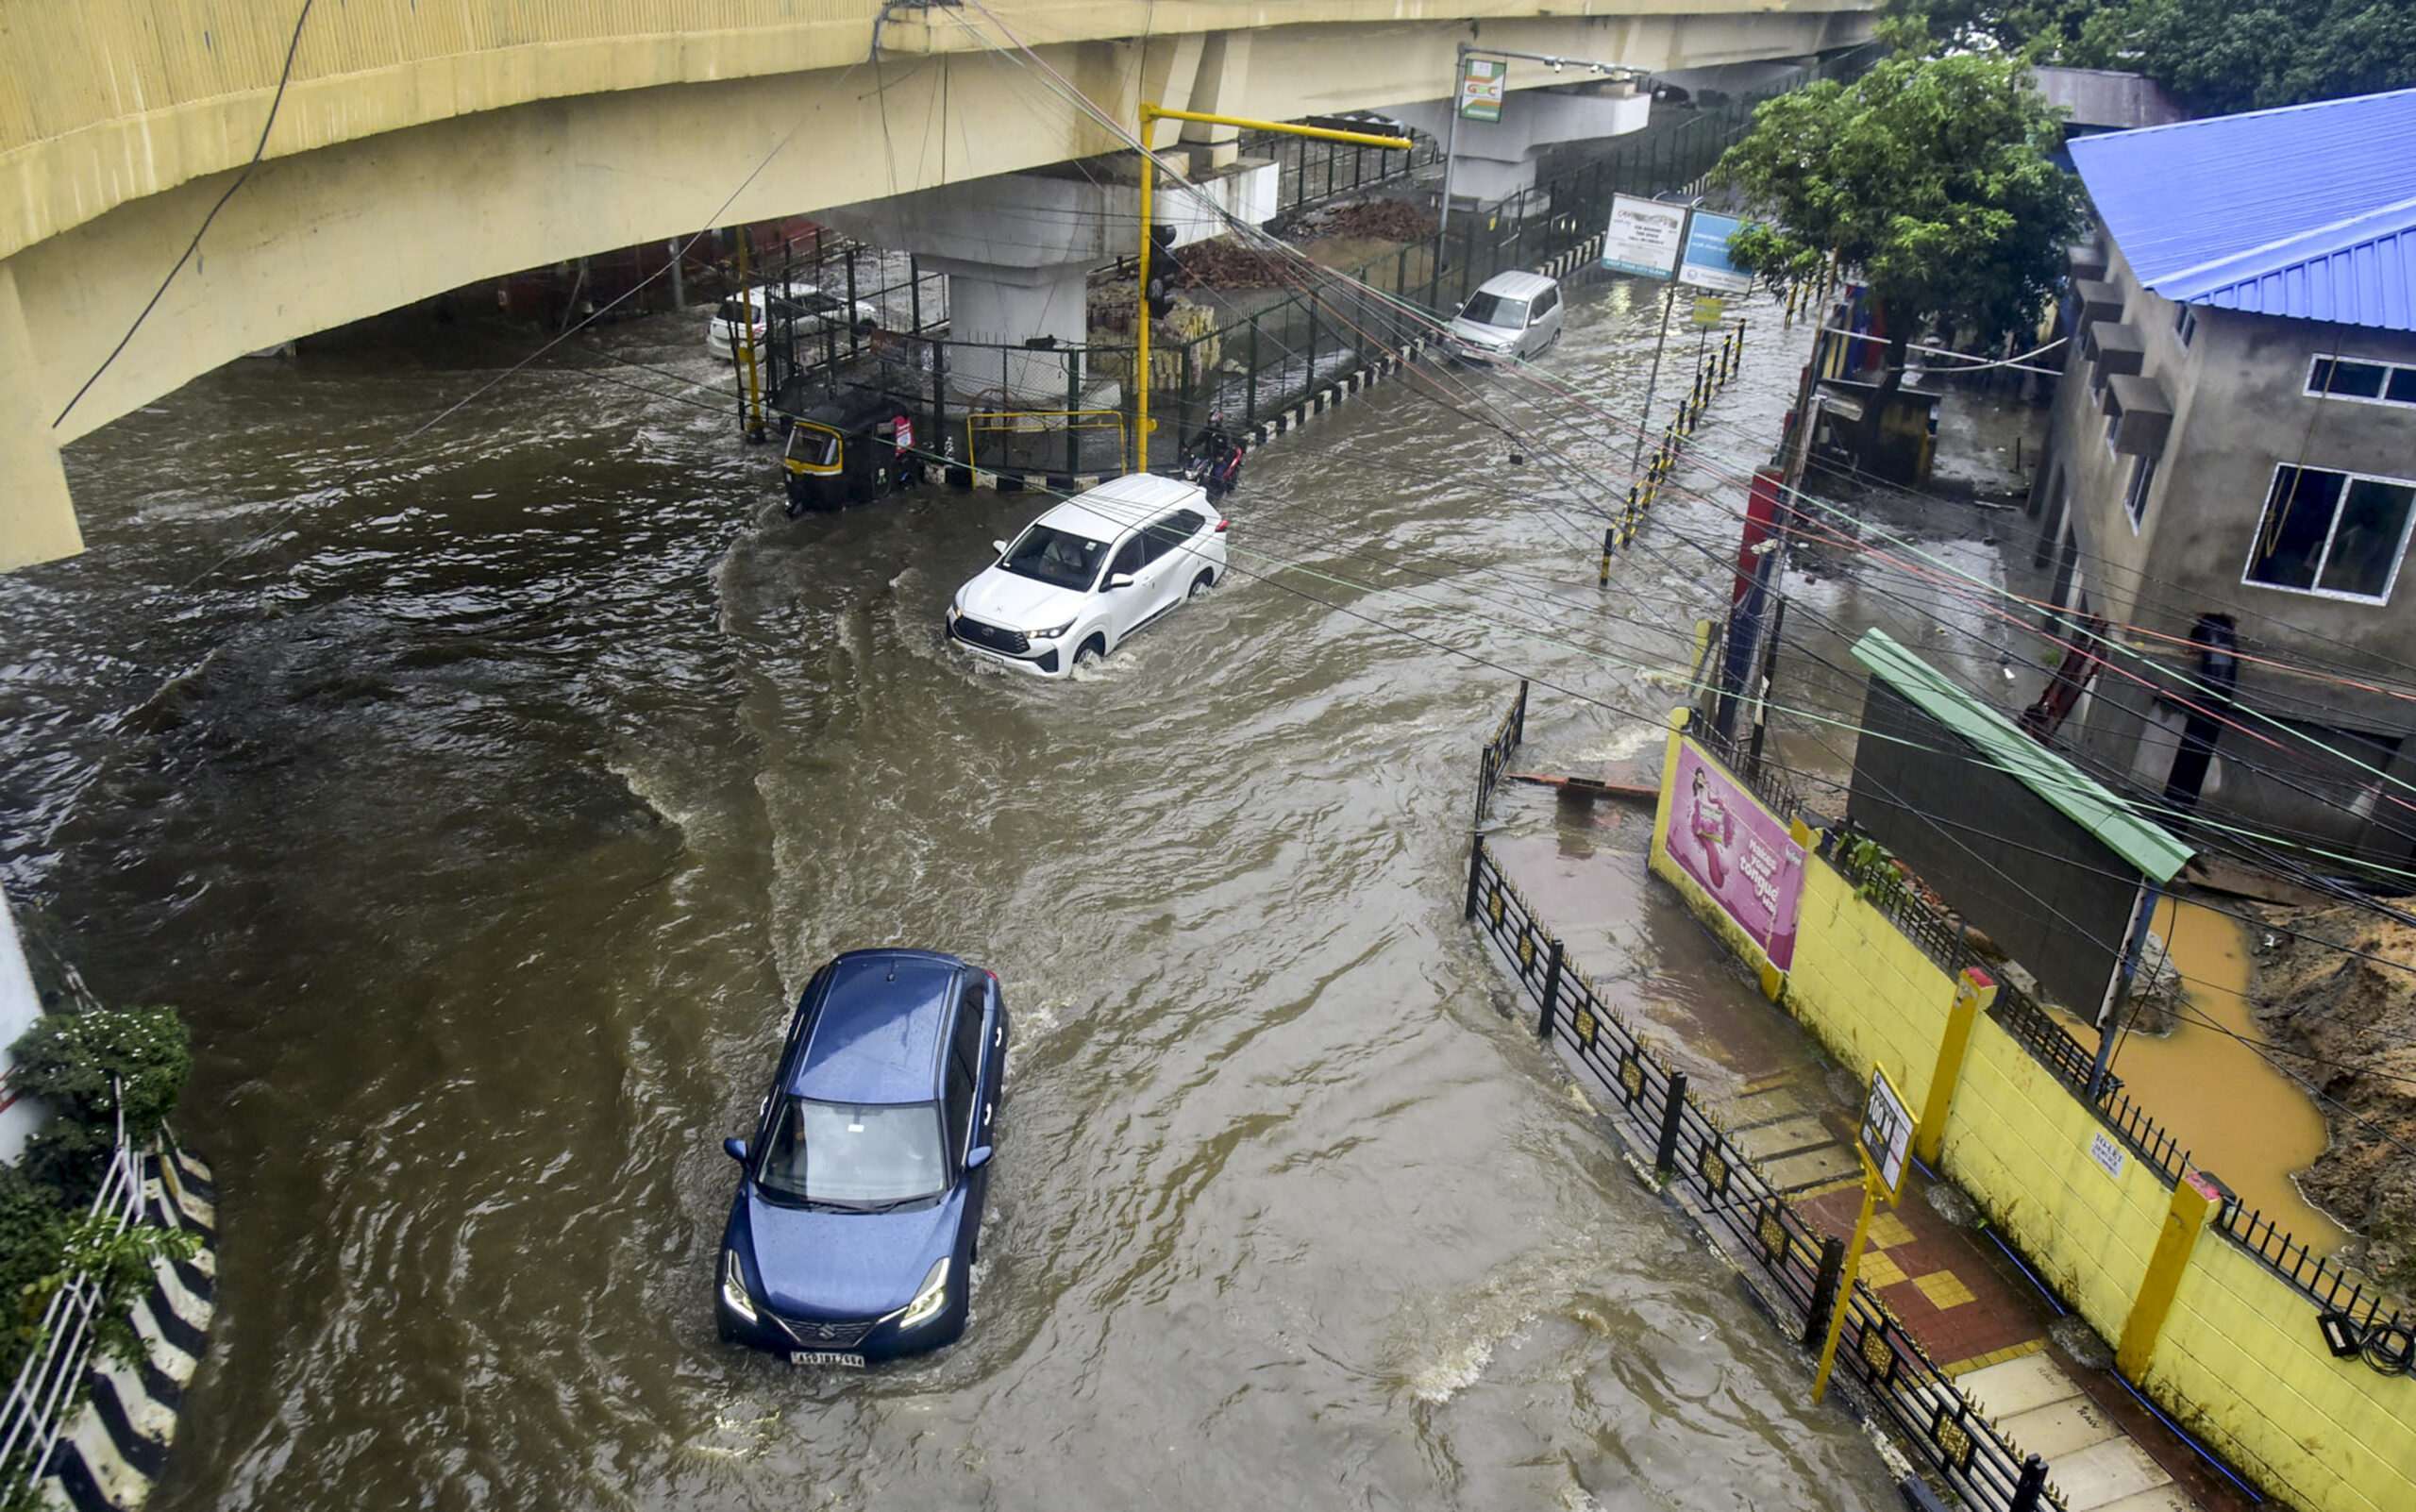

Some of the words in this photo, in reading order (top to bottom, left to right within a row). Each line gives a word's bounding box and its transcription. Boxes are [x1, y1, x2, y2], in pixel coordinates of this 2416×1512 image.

[1749, 839, 1776, 870] Makes
[1752, 854, 1771, 878] your
[1739, 855, 1779, 903] tongue
[1868, 1095, 1884, 1128] 100
